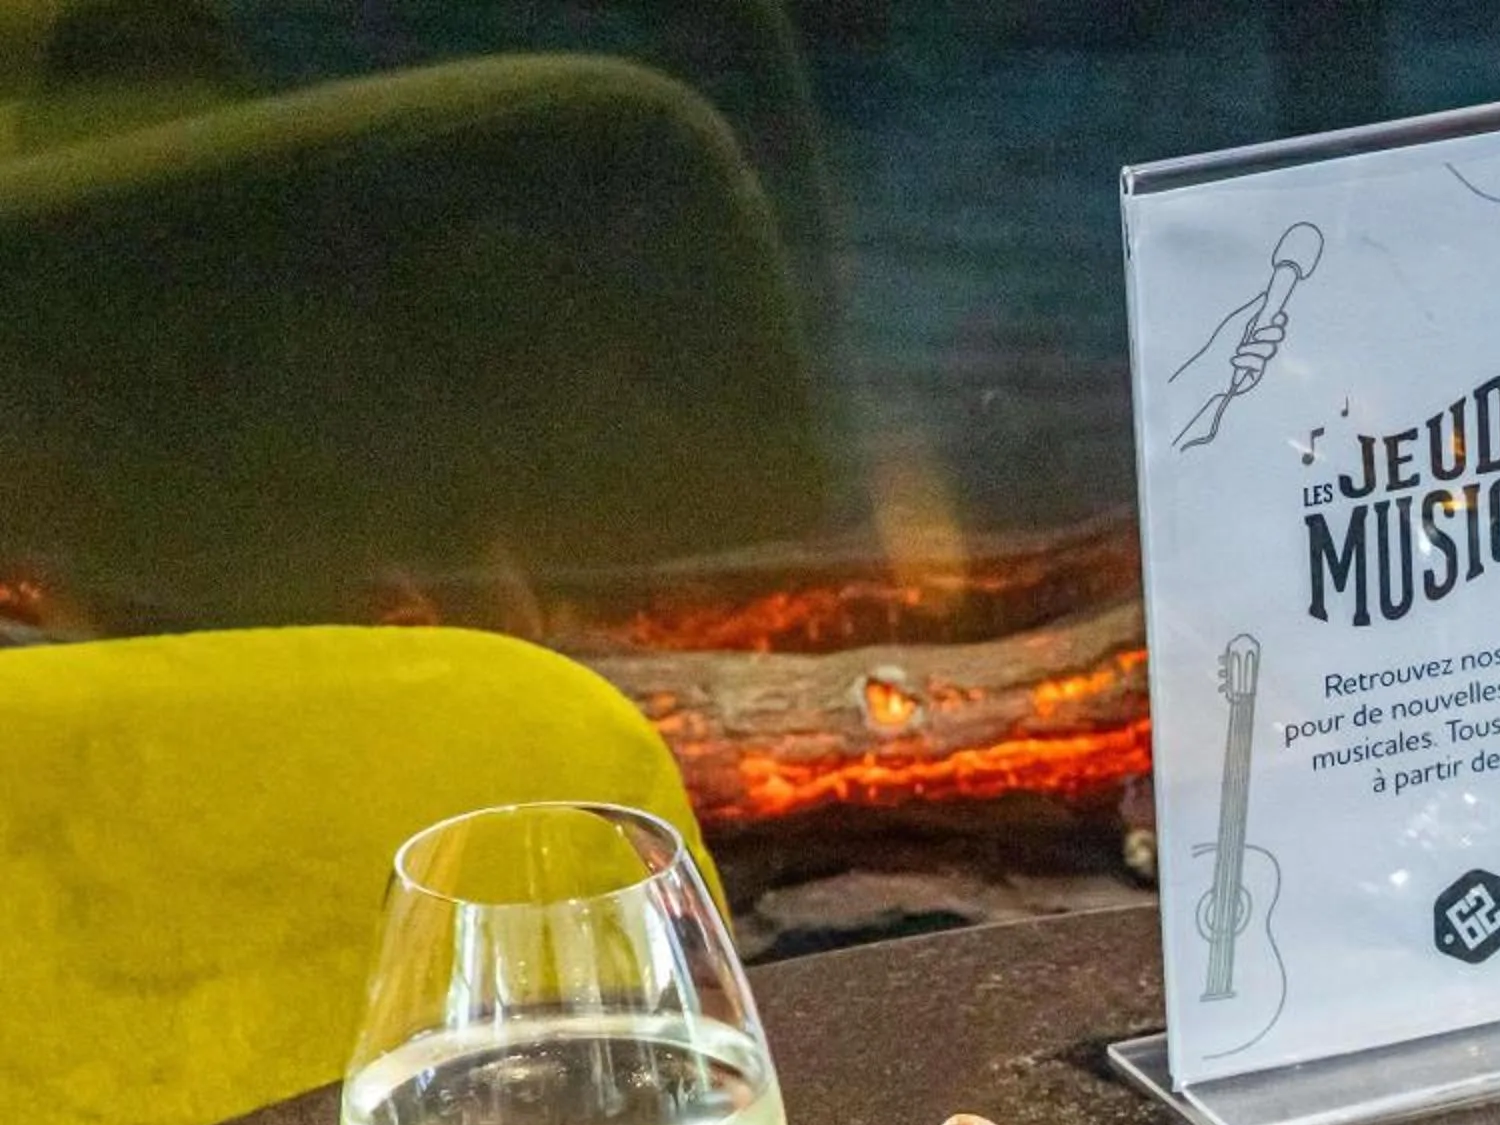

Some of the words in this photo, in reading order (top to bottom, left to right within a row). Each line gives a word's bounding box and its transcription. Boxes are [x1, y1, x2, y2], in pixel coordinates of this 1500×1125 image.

[1303, 483, 1333, 507] LES
[1324, 657, 1453, 698] Retrouvez
[1285, 714, 1346, 748] pour
[1353, 703, 1384, 728] de
[1312, 730, 1438, 771] musicales.
[1372, 767, 1387, 794] à
[1394, 757, 1462, 796] partir
